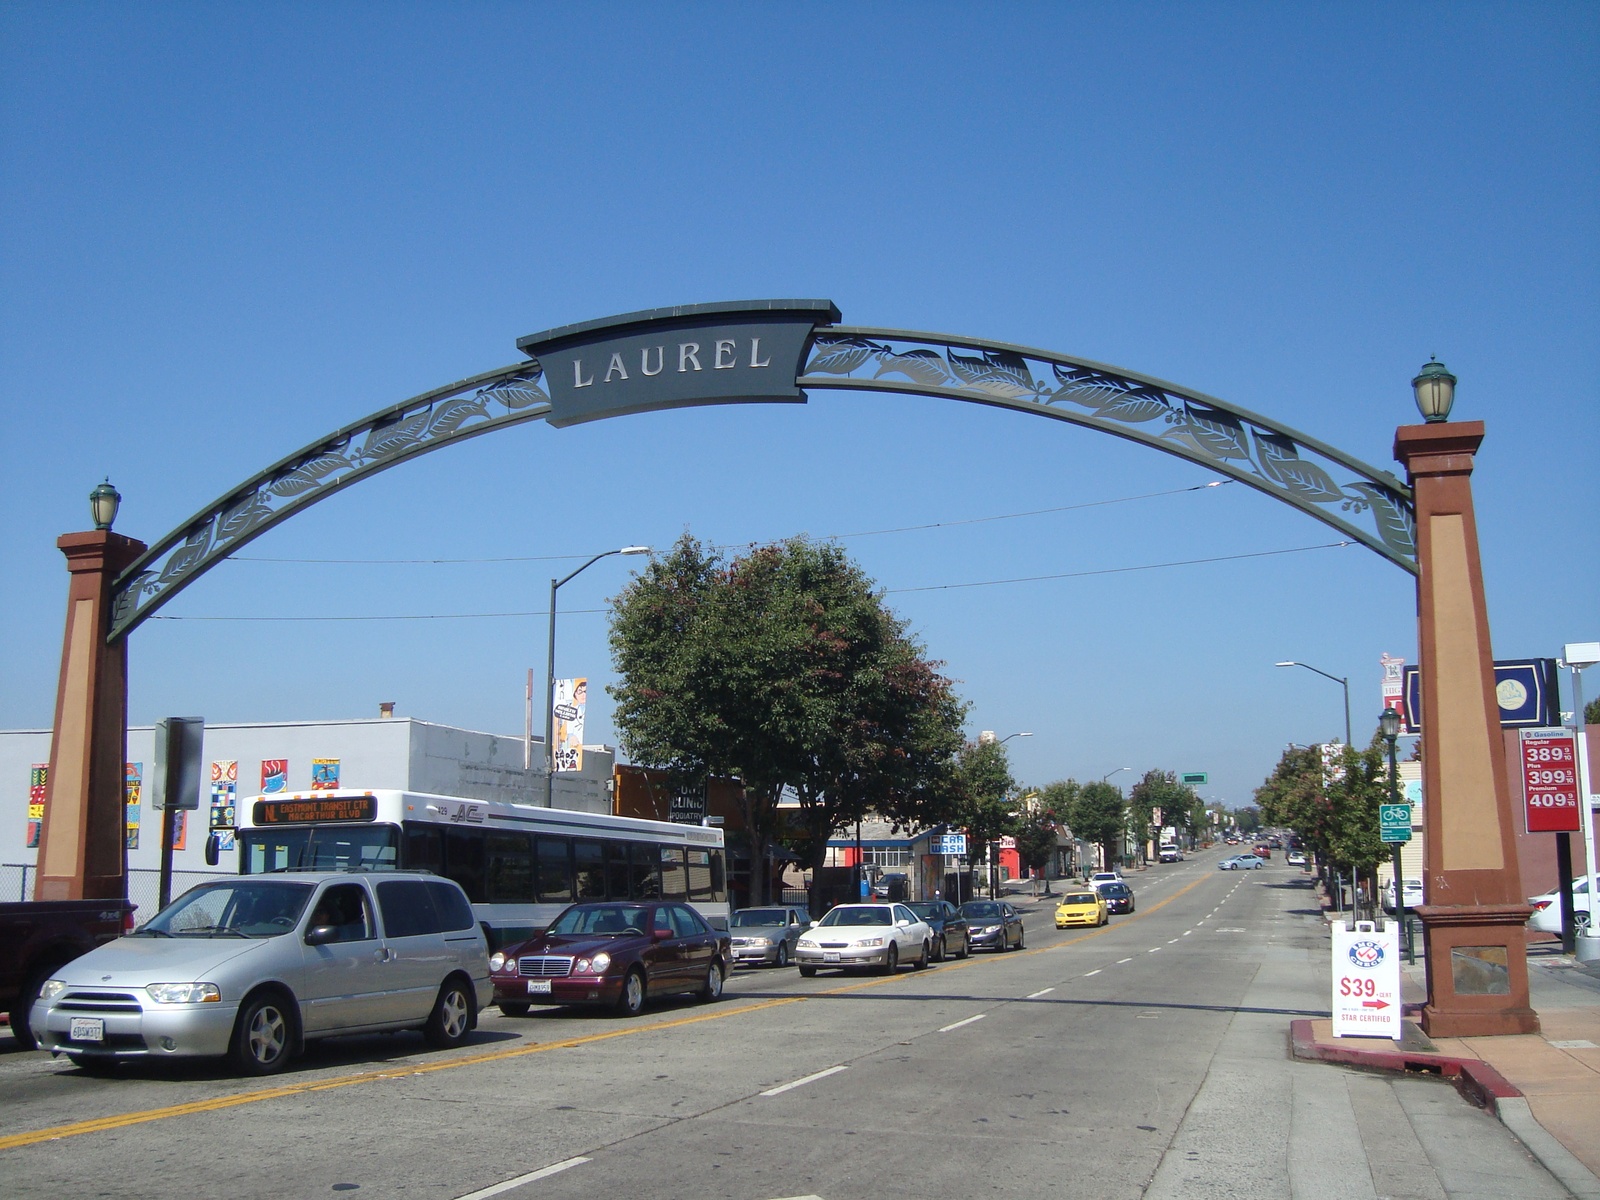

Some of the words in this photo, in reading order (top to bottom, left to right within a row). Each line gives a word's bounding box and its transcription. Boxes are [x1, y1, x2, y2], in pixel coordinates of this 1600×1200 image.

[573, 337, 772, 389] LAUREL
[1526, 747, 1563, 762] 389
[1528, 770, 1565, 784] 399
[280, 802, 318, 813] EASTMONT
[320, 801, 351, 811] TRANSIT
[353, 800, 368, 810] CTR
[672, 796, 703, 808] CLINIC
[1529, 793, 1567, 807] 409
[264, 804, 278, 822] NL
[288, 810, 336, 821] MACARTHUR
[339, 809, 360, 818] BLVD
[450, 804, 484, 823] AC
[671, 812, 702, 820] PODIATRY
[941, 836, 964, 844] CAR
[931, 845, 964, 853] WASH
[1339, 975, 1376, 998] $39
[1359, 1014, 1391, 1023] CERTIFIED
